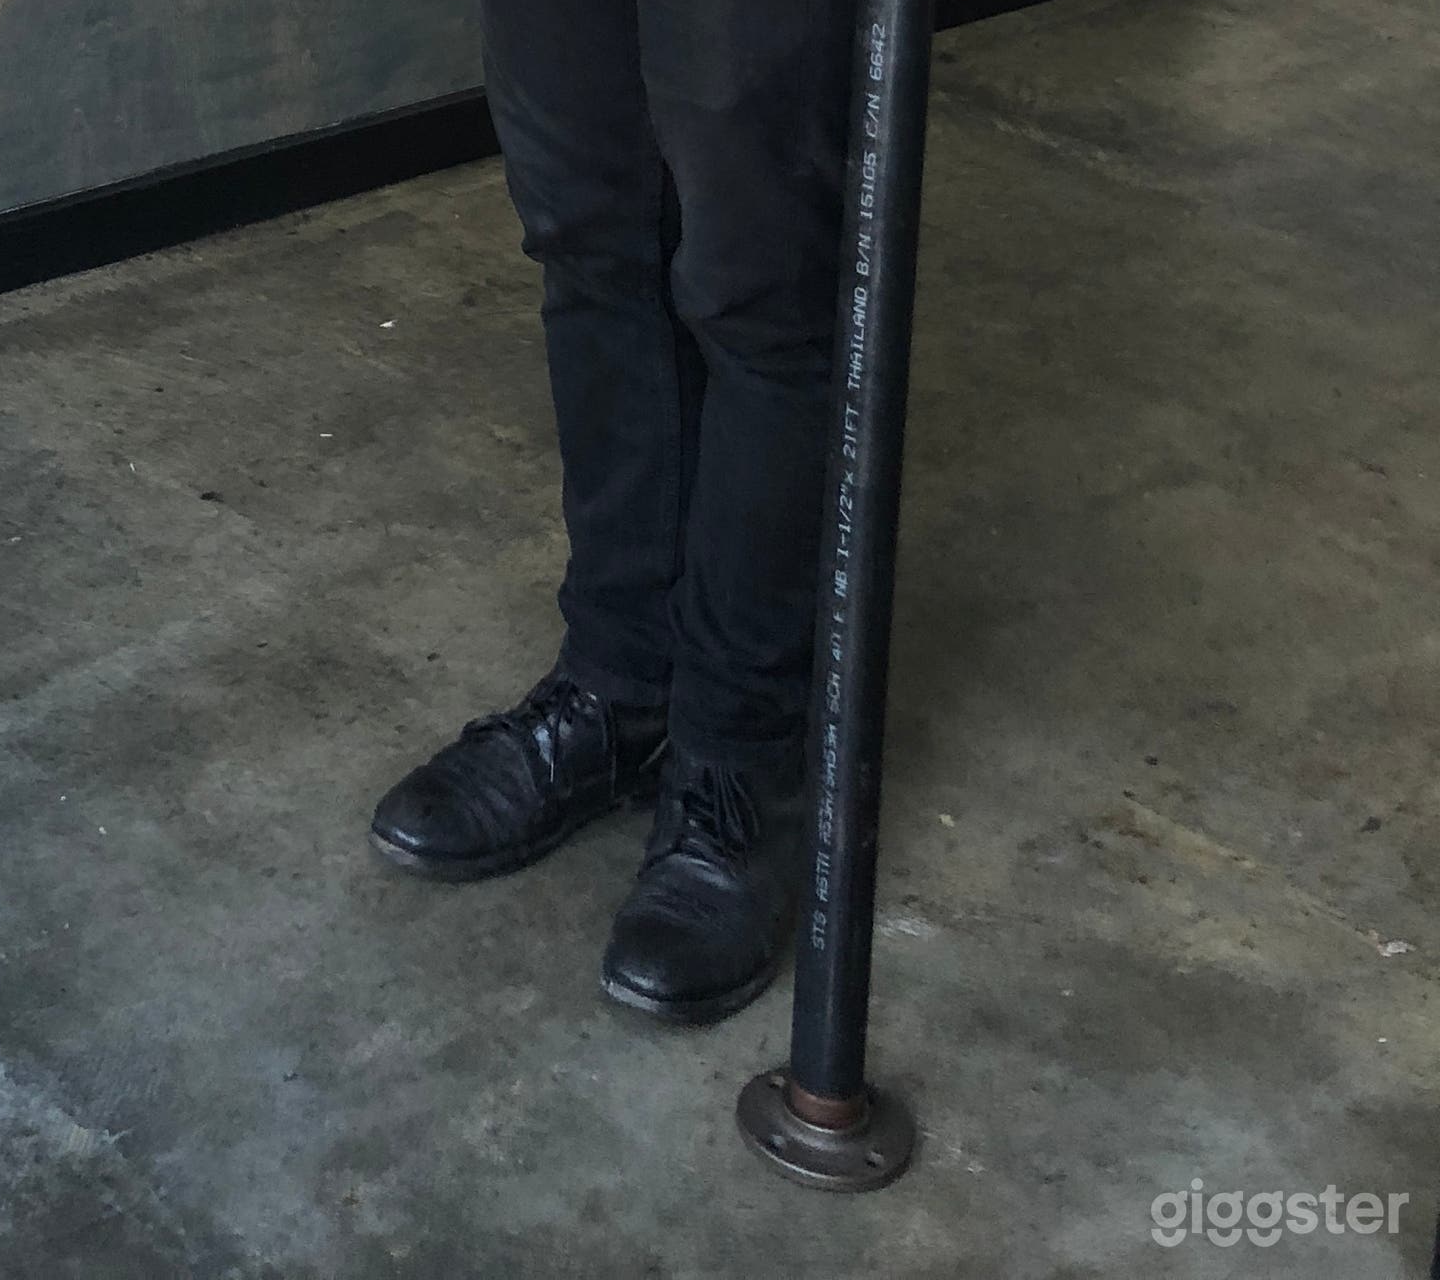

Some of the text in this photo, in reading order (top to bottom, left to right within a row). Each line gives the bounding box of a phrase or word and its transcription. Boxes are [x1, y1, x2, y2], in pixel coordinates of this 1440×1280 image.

[870, 23, 885, 80] 6642
[866, 94, 880, 138] C/N
[856, 233, 871, 276] B/N
[847, 286, 868, 390] THAILAND
[843, 402, 859, 459] 21FT
[834, 570, 849, 597] NB
[812, 910, 827, 951] STS
